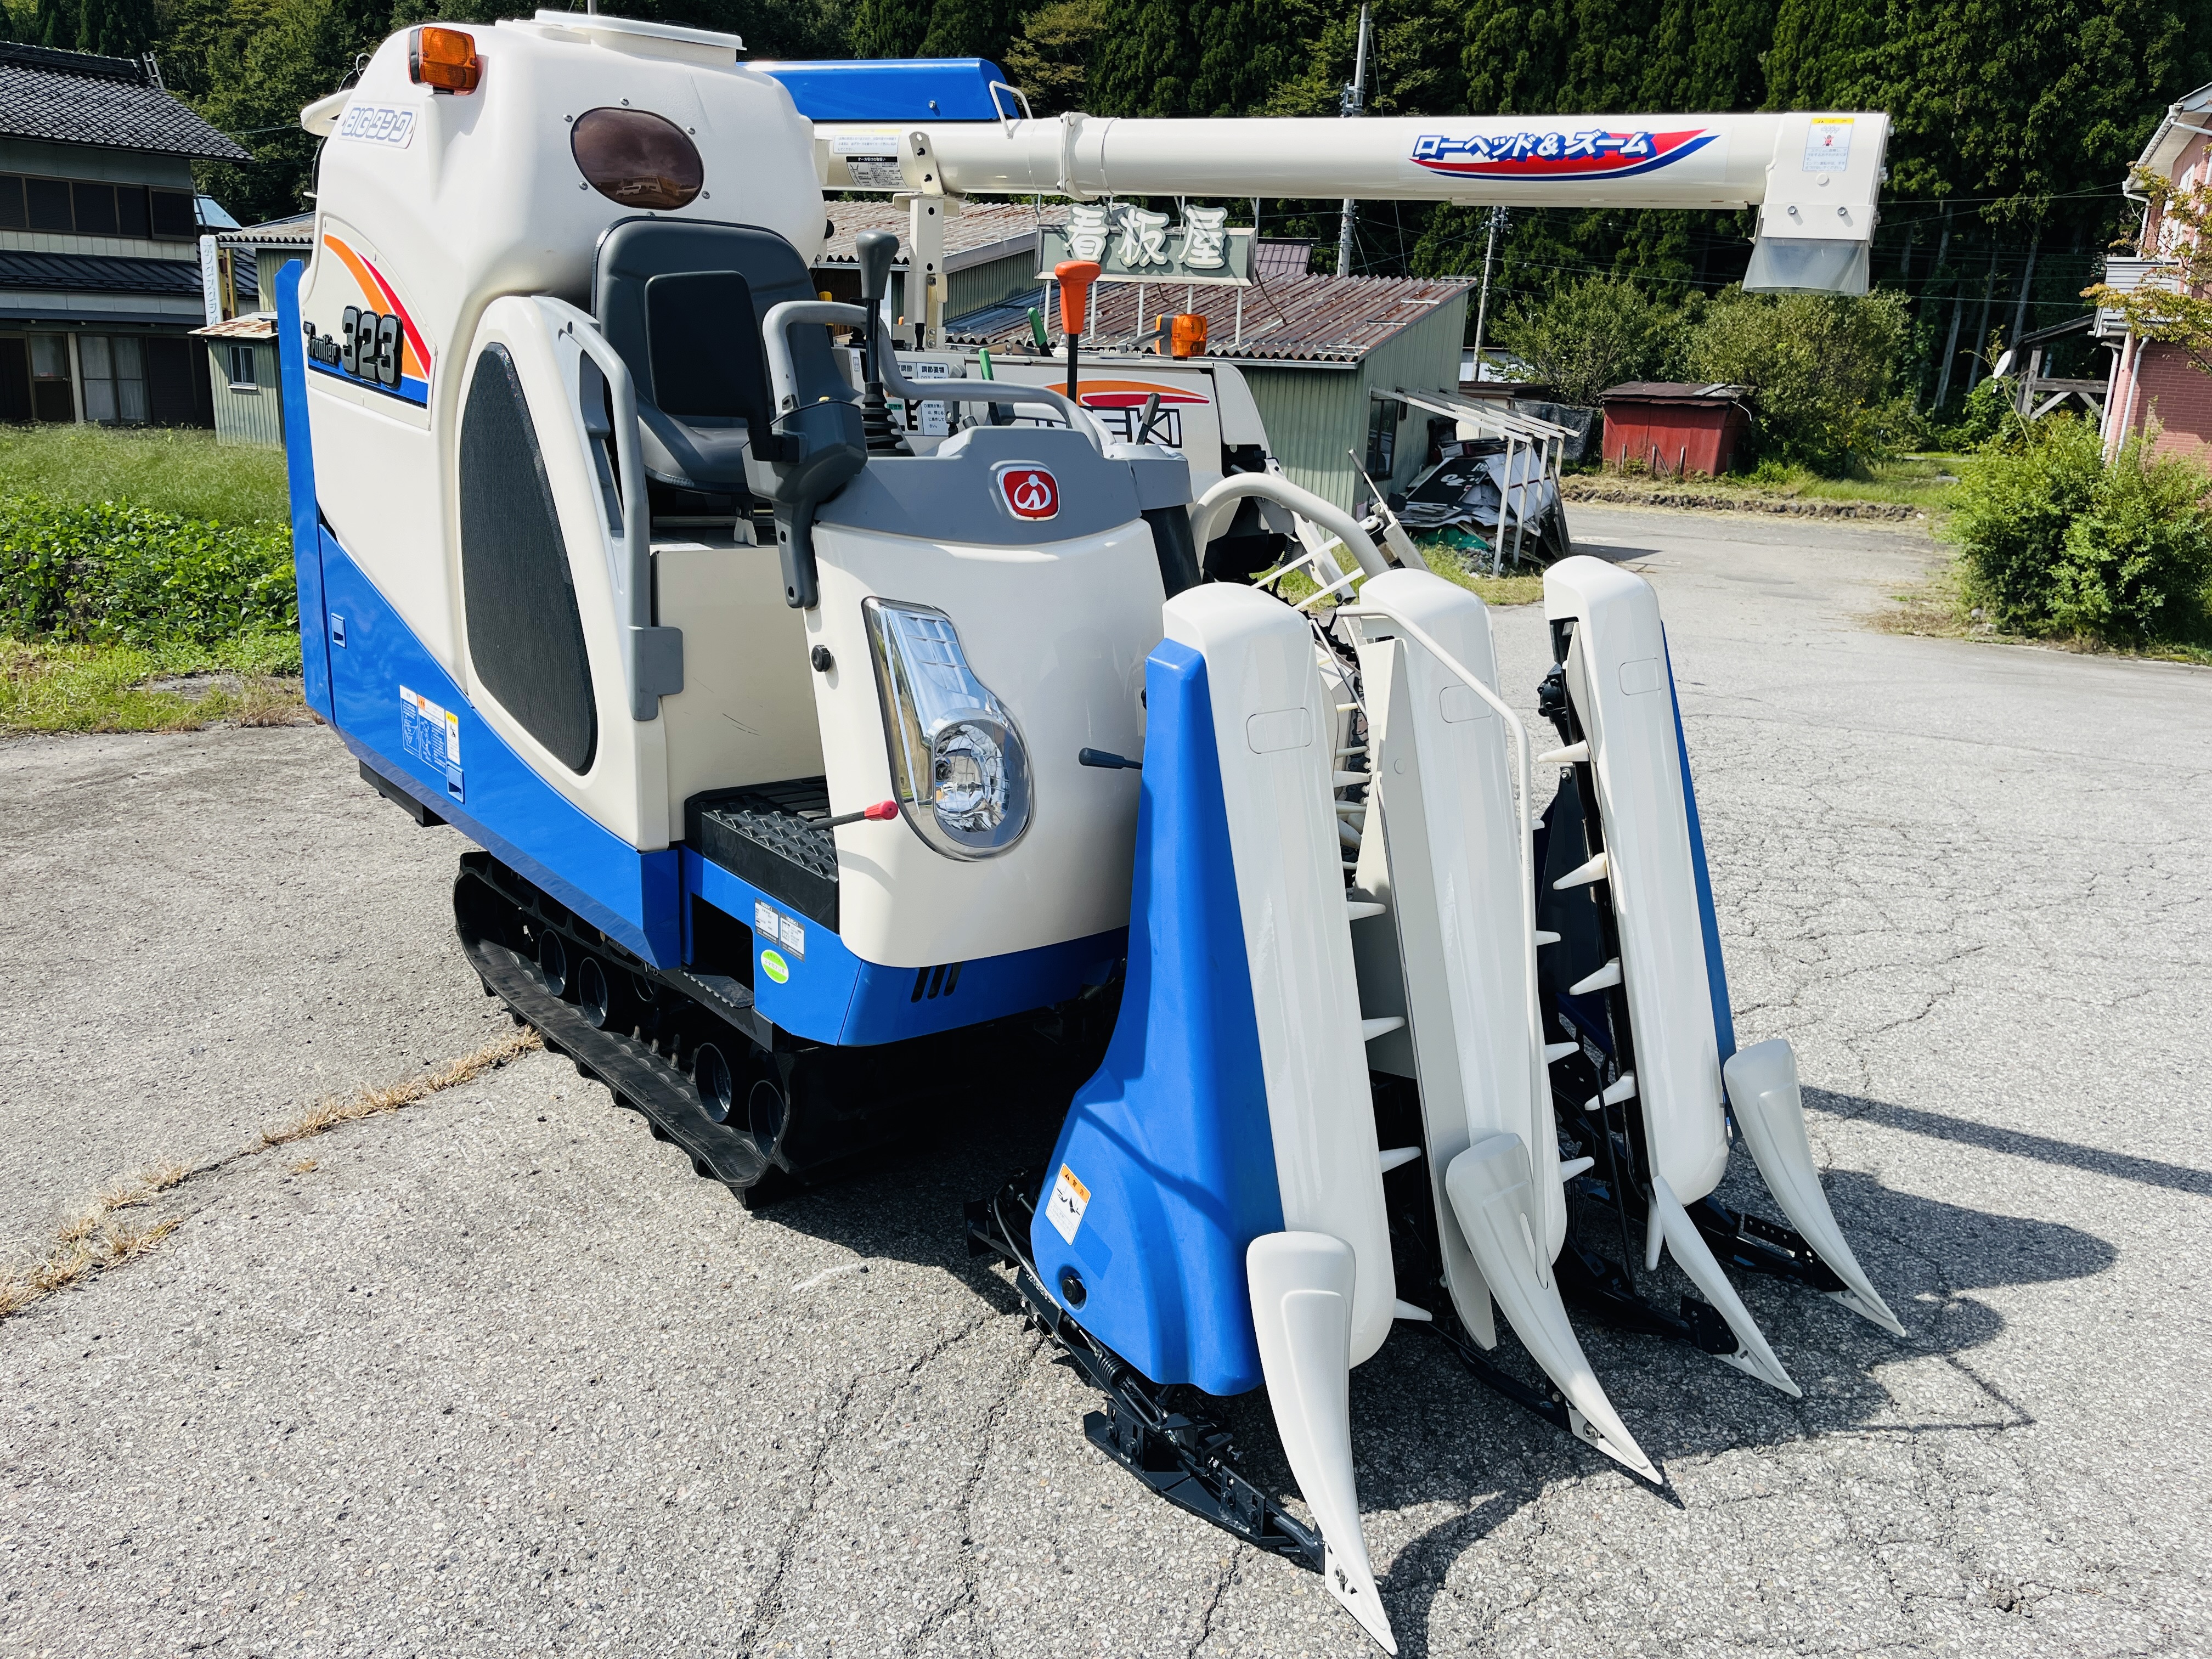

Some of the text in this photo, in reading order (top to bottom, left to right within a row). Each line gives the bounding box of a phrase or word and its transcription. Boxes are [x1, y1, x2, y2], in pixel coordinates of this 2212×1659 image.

[341, 107, 413, 143] BIGタンク
[1063, 205, 1226, 267] 看板屋
[341, 304, 404, 389] 323
